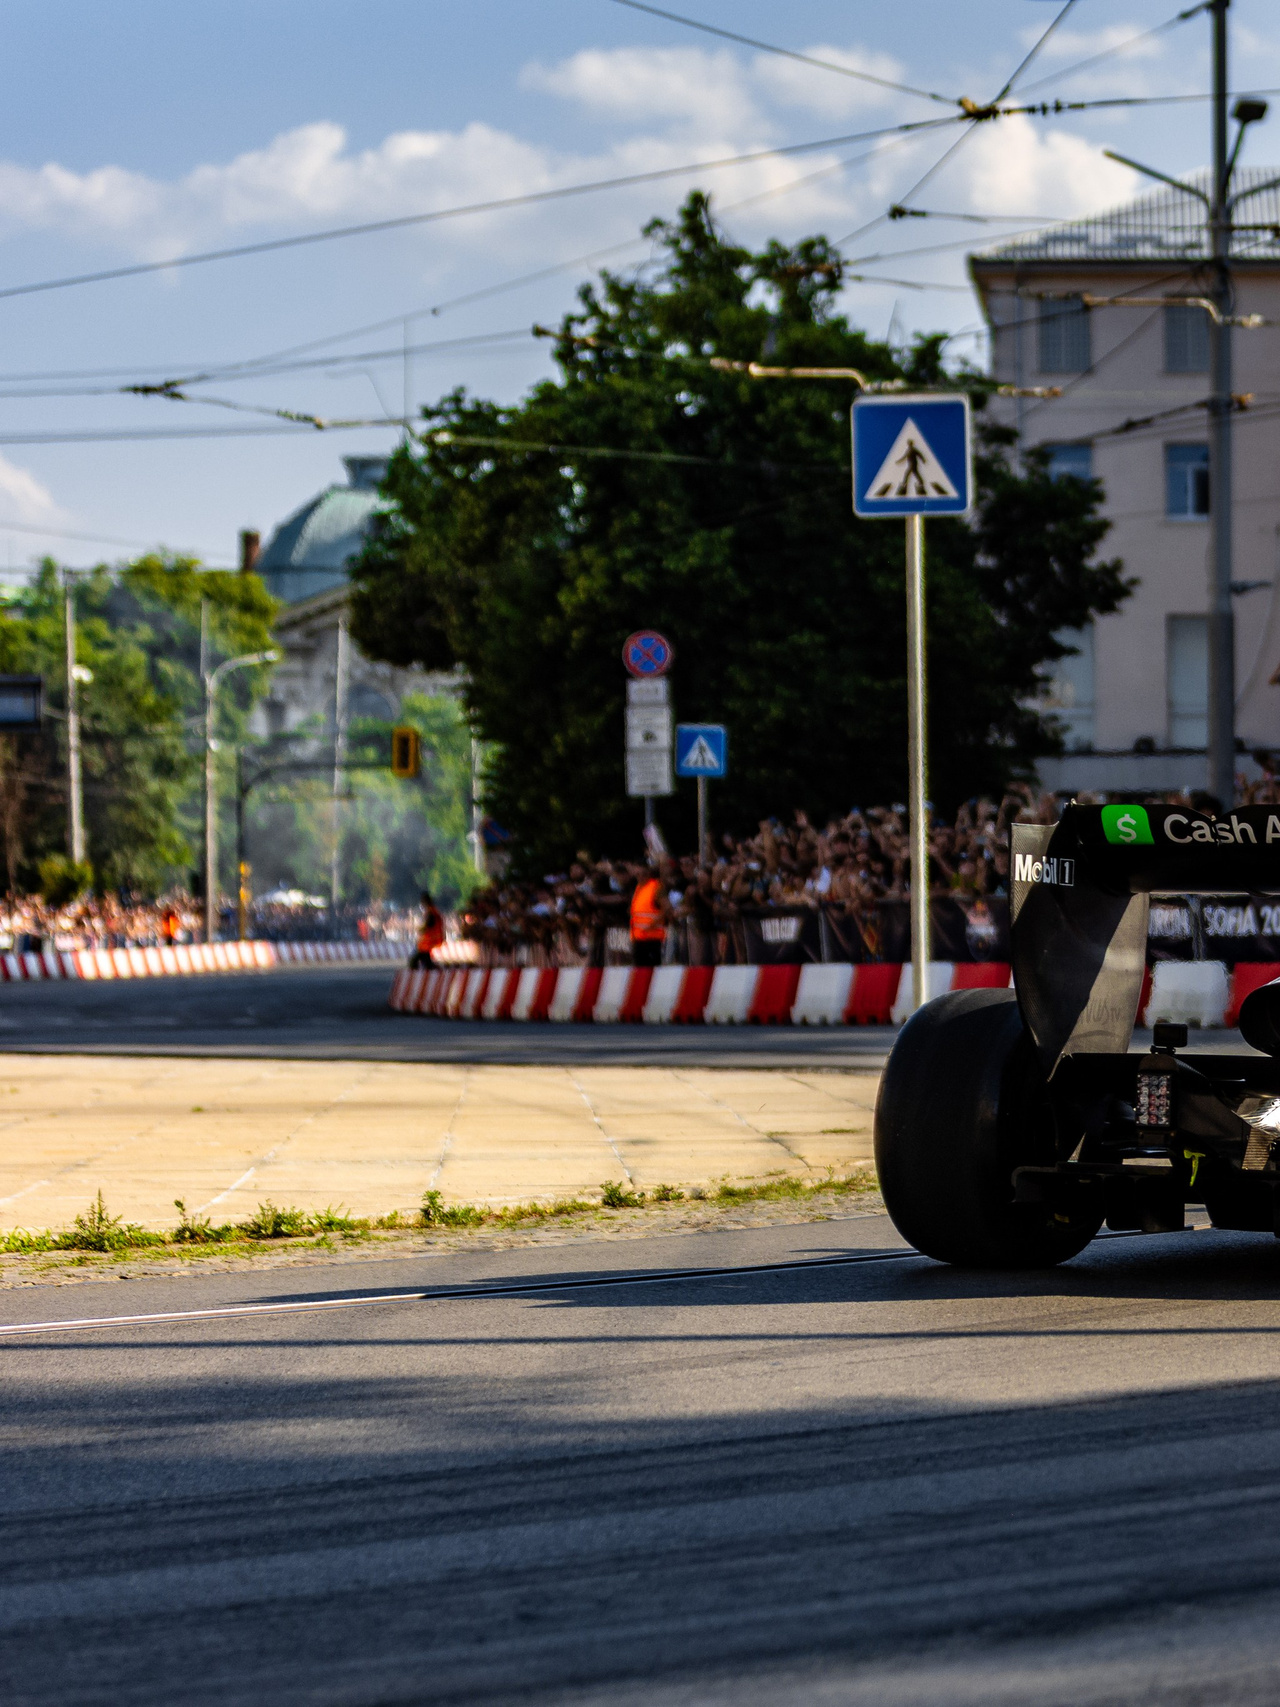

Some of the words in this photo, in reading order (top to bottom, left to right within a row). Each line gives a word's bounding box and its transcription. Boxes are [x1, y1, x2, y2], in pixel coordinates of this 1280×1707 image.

[1163, 814, 1257, 844] Cash
[1015, 853, 1058, 884] Mobil
[1061, 860, 1072, 884] 1
